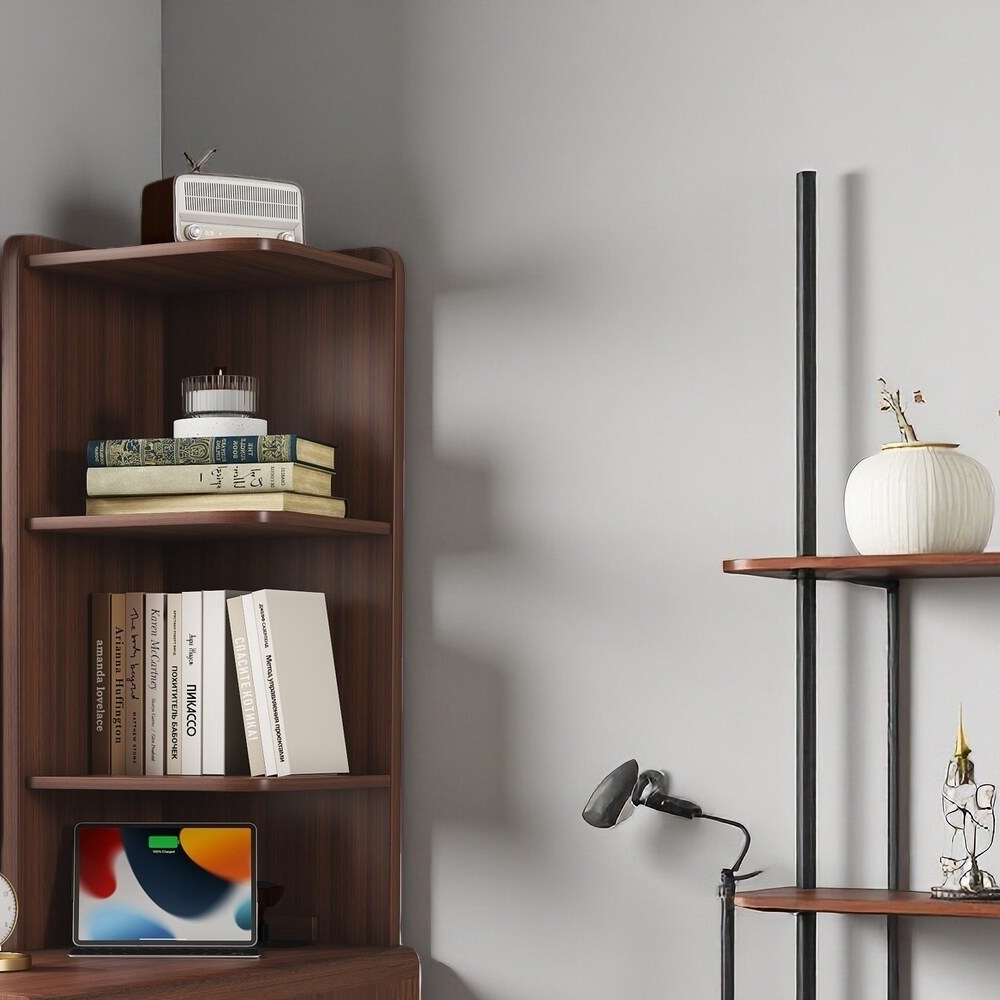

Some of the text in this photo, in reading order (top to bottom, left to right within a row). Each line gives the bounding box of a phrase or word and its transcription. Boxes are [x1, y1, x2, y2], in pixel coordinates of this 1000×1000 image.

[96, 640, 106, 732] amanda lovelace
[112, 626, 124, 744] Arianna Huffington
[147, 608, 160, 691] Karen McCartney
[234, 637, 258, 741] СПАСИТЕ КОТИКА!
[186, 684, 197, 737] ПИКАССО
[264, 654, 286, 763] Метод управления проектами
